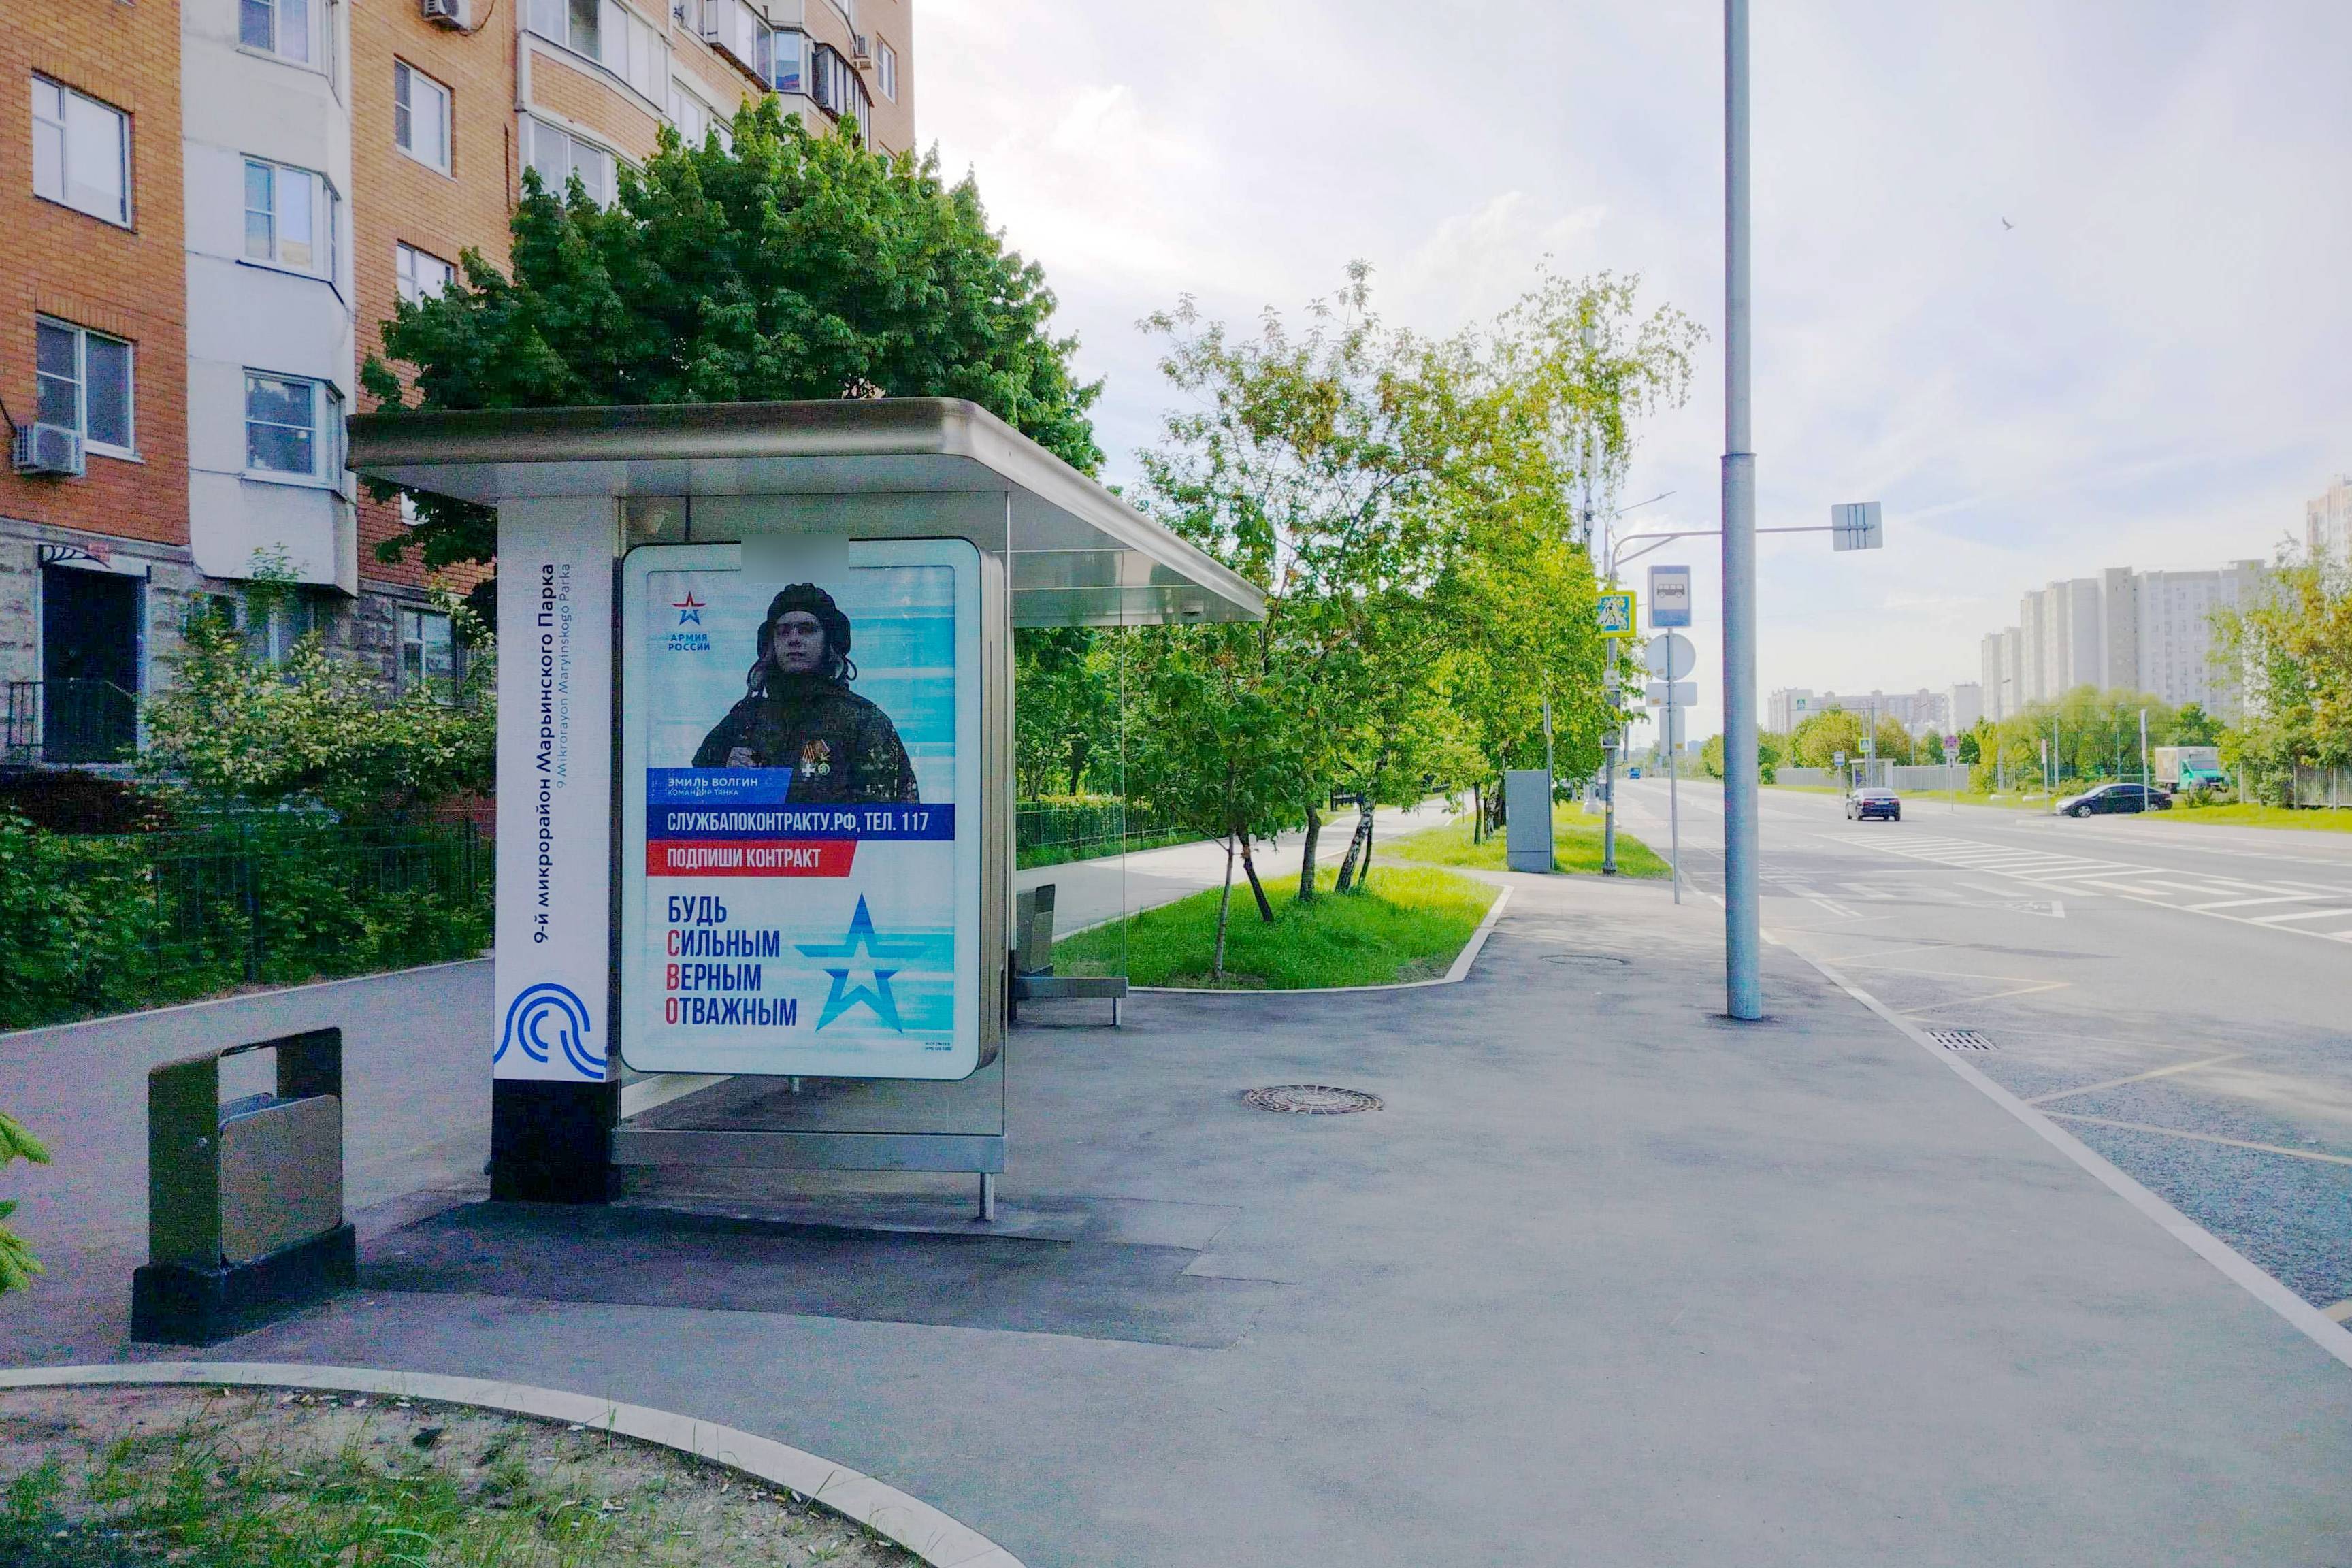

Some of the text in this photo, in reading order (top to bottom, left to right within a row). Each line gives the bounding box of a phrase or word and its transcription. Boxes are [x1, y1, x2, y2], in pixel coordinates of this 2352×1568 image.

[557, 564, 572, 789] 9 Mikrorayon Maryinskogo Parka
[534, 564, 557, 943] 9-й микрорайон Марьинского Парка
[668, 778, 758, 787] ЭМИЛЬ ВОЛГИН
[667, 812, 928, 833] СЛУЖБАПОКОНТРАКТУ.РФ, ТЕЛ. 117
[668, 849, 821, 869] ПОДПИШИ КОНТРАКТ
[668, 896, 727, 926] БУДЬ
[667, 929, 780, 958] СИЛЬНЫМ
[666, 963, 762, 991] ВЕРНЫМ
[666, 997, 797, 1026] ОТВАЖНЫМ
